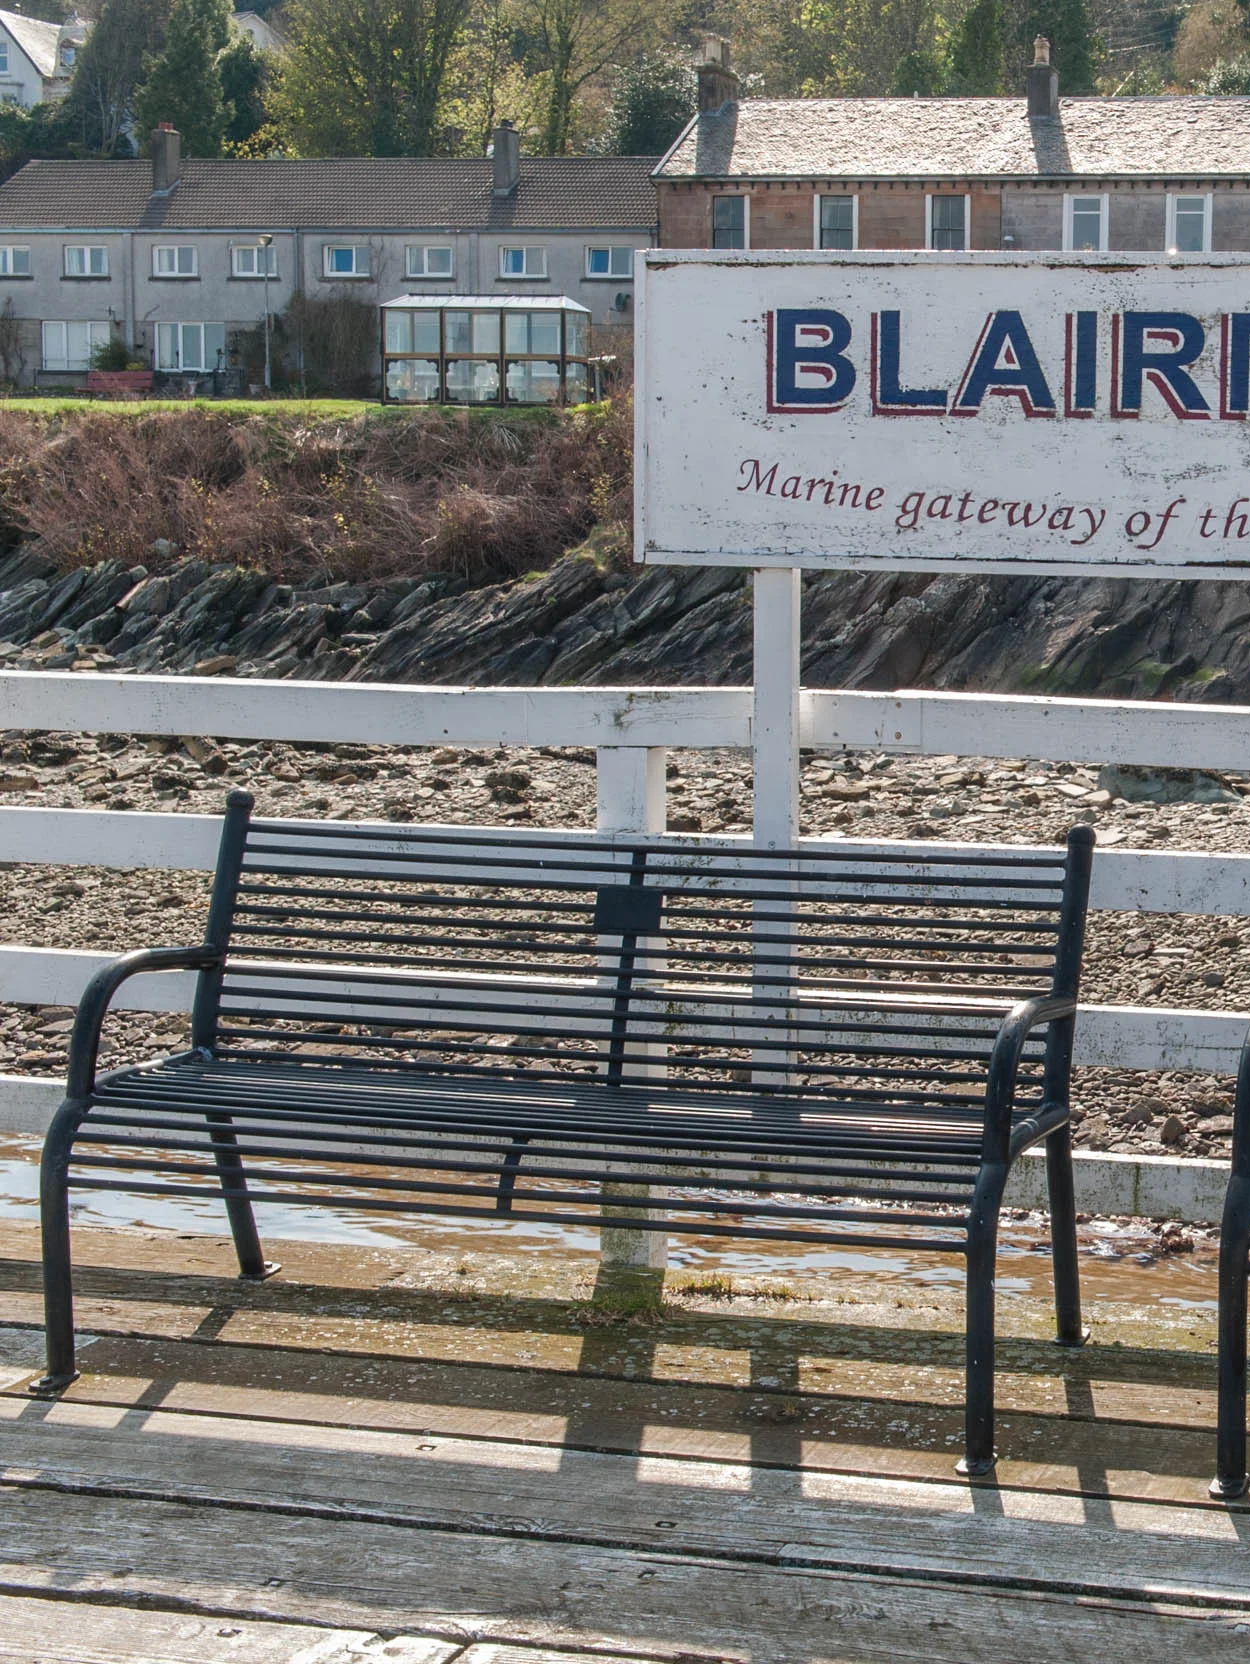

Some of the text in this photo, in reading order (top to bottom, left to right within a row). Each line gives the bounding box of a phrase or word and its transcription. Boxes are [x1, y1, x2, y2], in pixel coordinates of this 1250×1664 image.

[736, 458, 886, 511] Marine
[895, 490, 1107, 545] gateway
[1124, 497, 1188, 550] of
